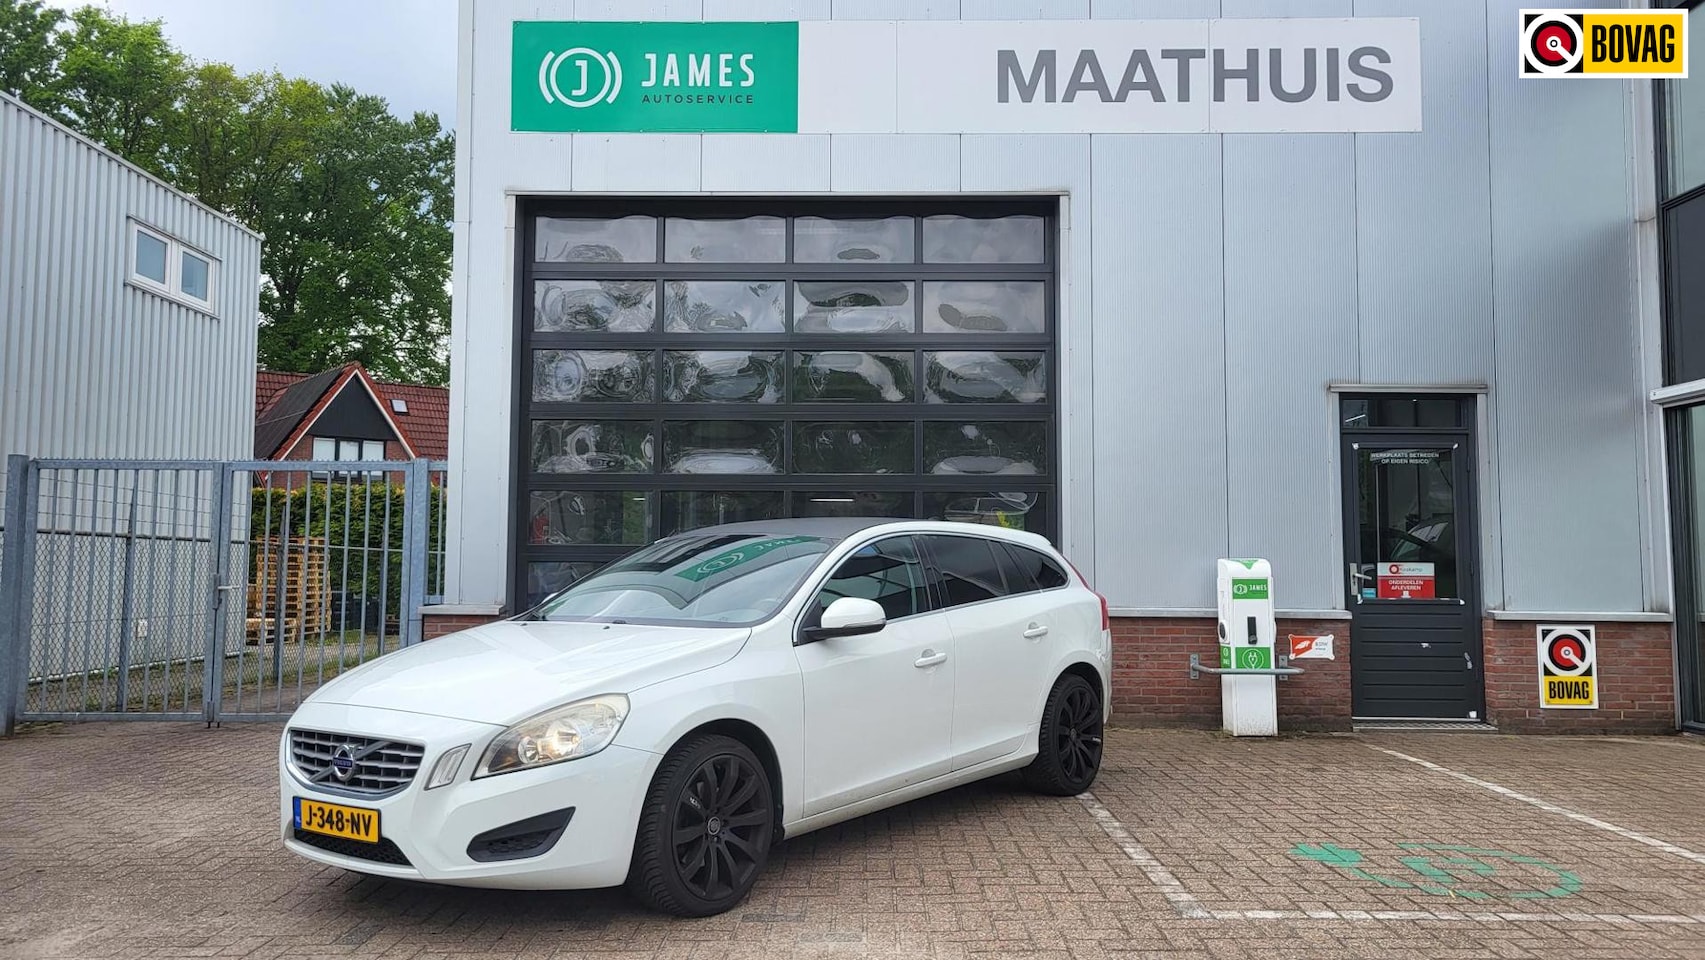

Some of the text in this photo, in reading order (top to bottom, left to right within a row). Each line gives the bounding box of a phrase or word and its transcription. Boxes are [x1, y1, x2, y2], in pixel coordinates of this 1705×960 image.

[571, 59, 588, 96] J
[641, 53, 755, 87] JAMES
[997, 46, 1394, 103] MAATHUIS
[641, 94, 754, 104] AUTOSERVICE
[1548, 681, 1590, 700] BOVAG
[305, 805, 372, 837] J-348-NV
